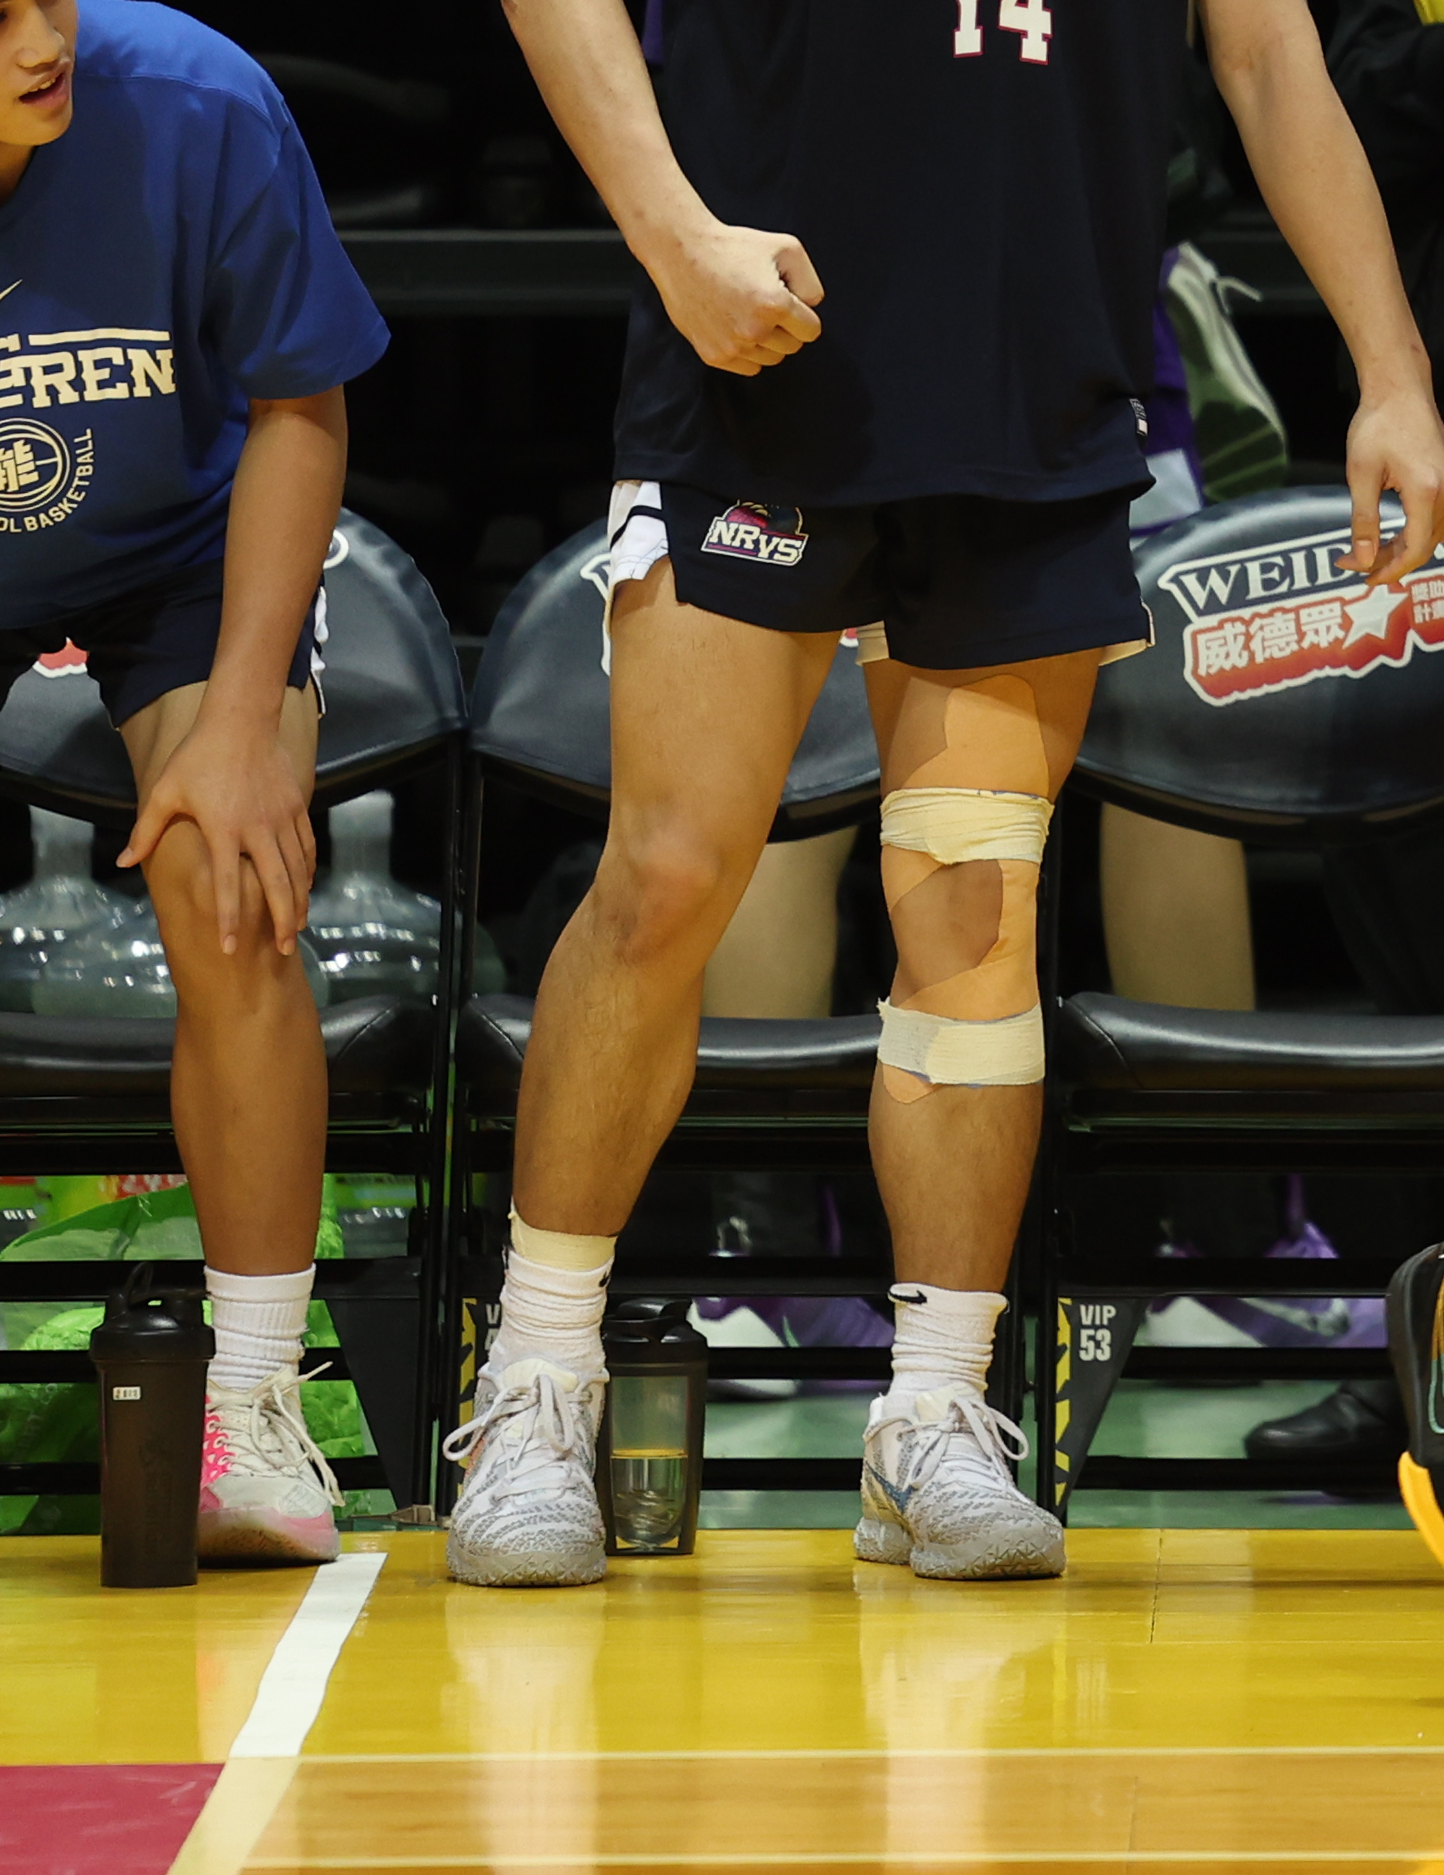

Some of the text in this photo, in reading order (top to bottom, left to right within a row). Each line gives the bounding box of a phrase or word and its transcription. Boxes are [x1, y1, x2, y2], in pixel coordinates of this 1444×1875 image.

[24, 428, 95, 532] BASKETBALL
[1196, 601, 1346, 677] 威德眾
[1080, 1304, 1116, 1325] VIP
[1079, 1329, 1111, 1361] 53
